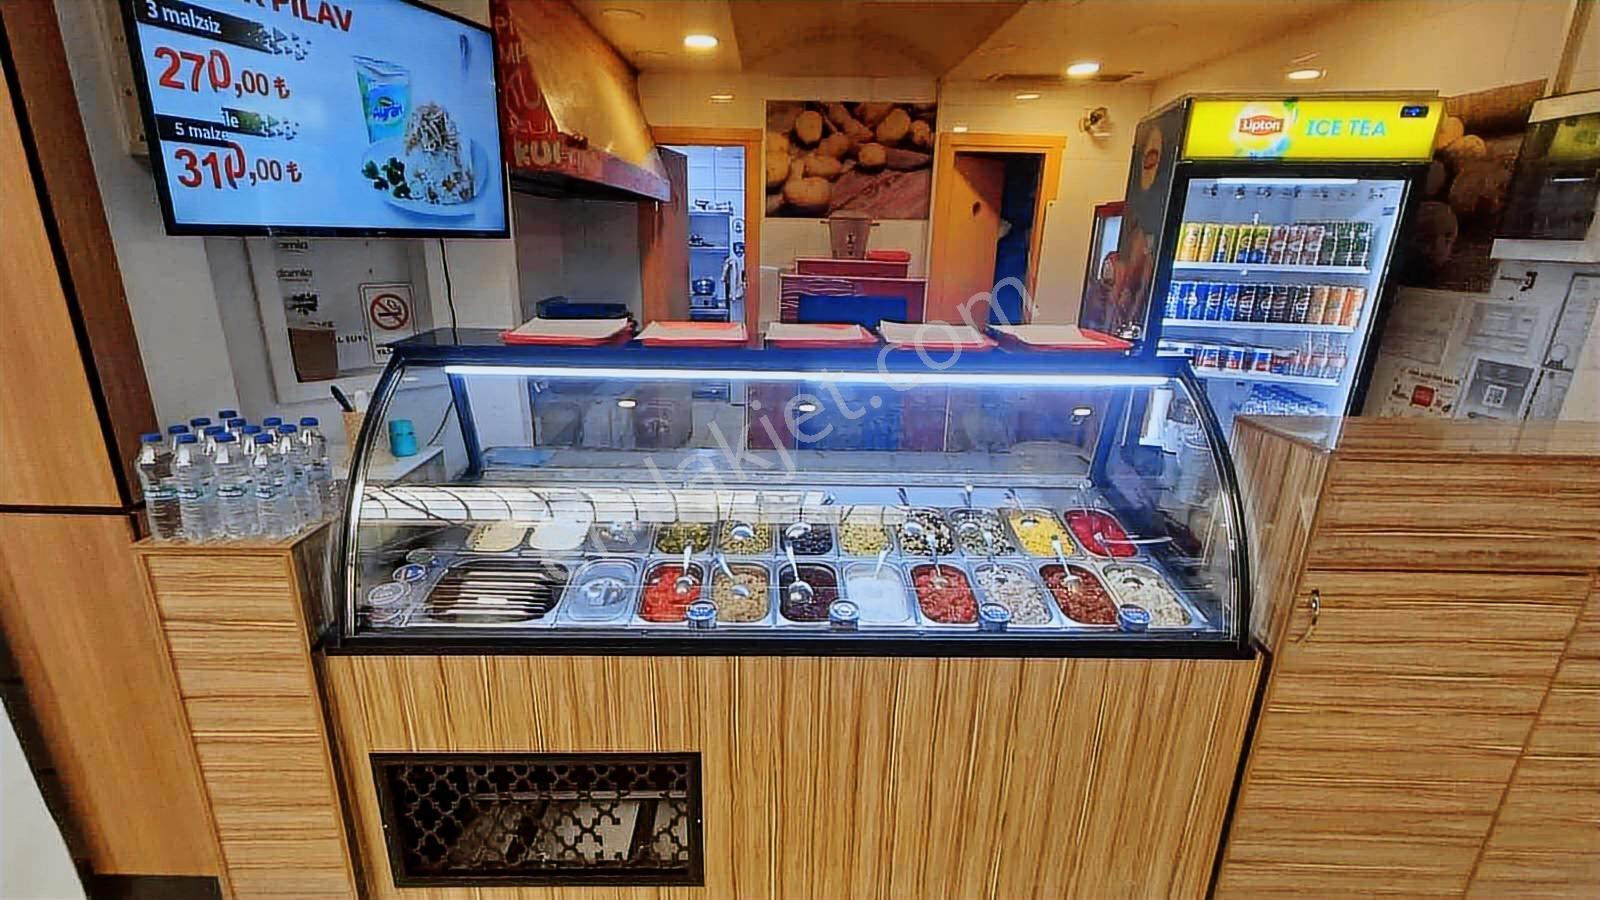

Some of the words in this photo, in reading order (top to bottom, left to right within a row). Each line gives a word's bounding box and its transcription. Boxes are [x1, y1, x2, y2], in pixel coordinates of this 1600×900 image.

[146, 0, 158, 18] 3
[174, 121, 185, 136] 5
[1241, 117, 1281, 134] Lipton
[1306, 119, 1342, 136] ICE
[1350, 119, 1386, 136] TEA
